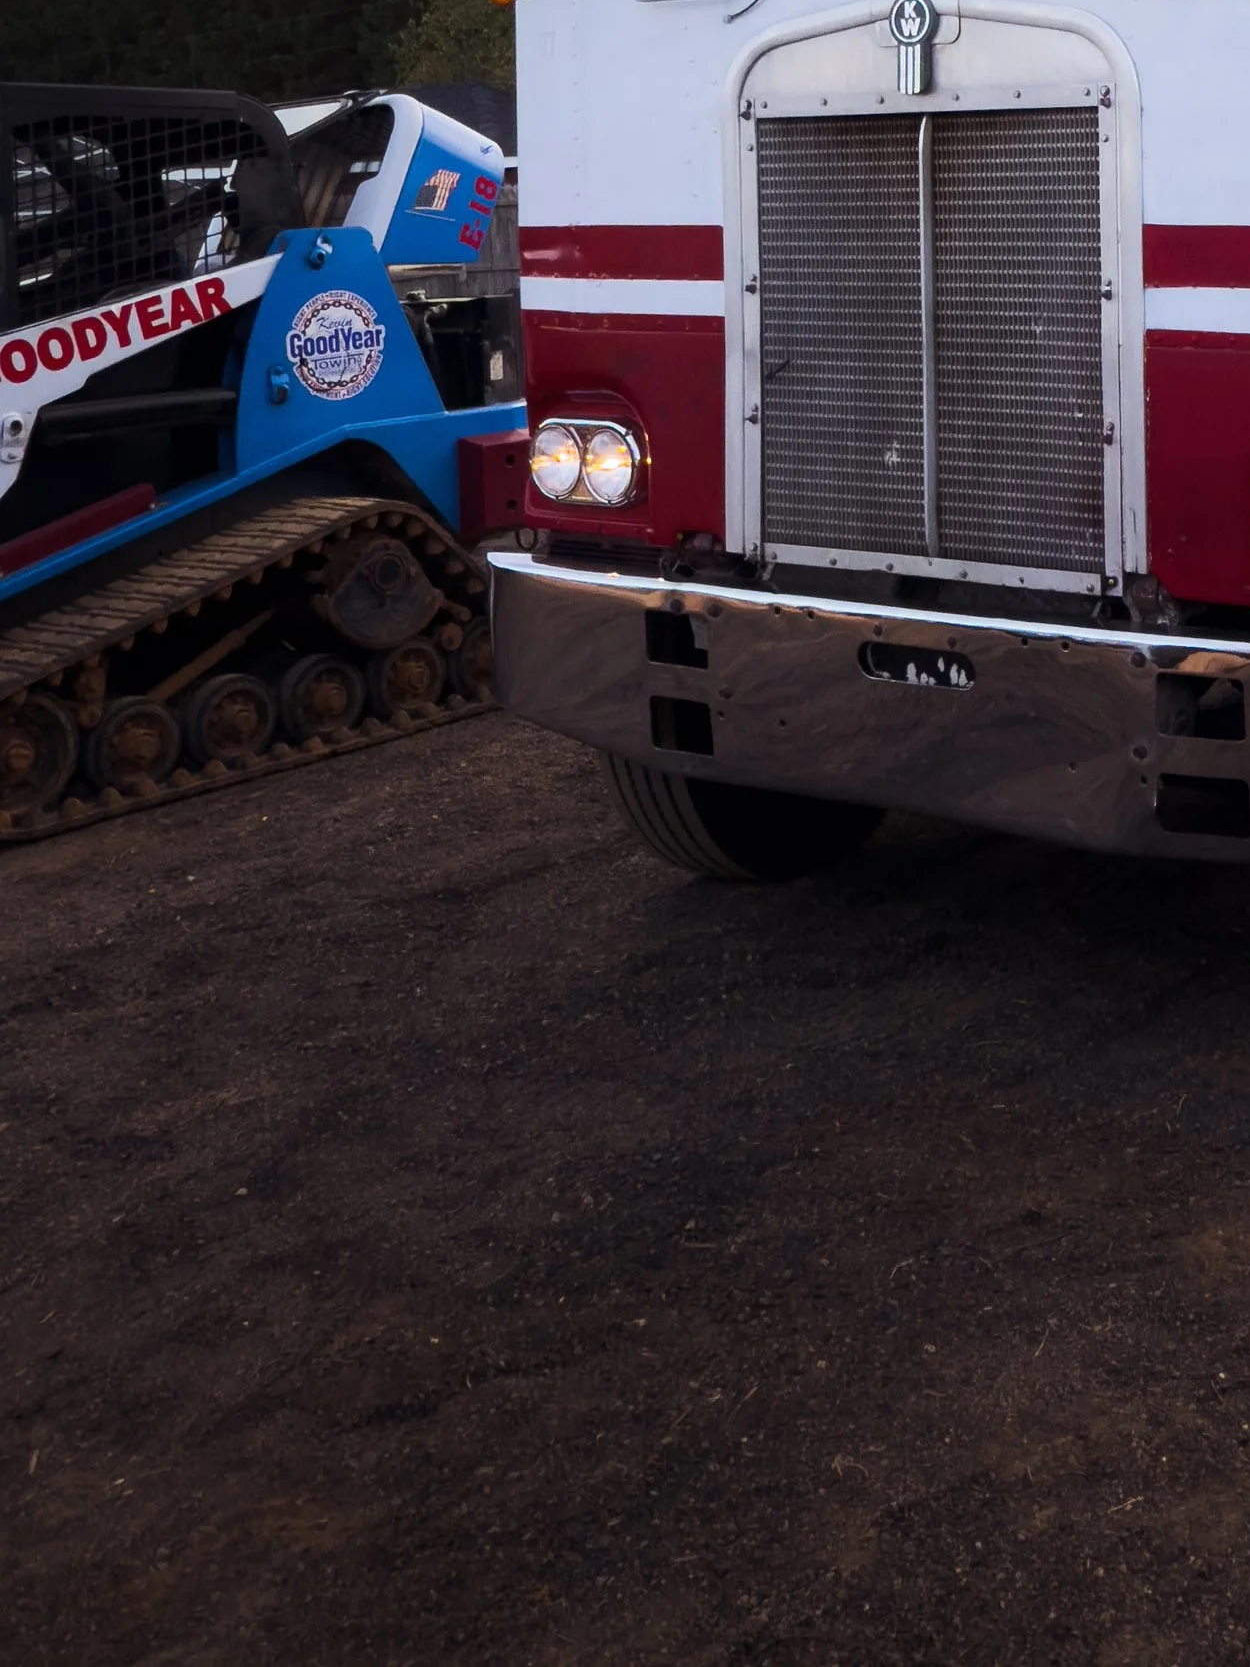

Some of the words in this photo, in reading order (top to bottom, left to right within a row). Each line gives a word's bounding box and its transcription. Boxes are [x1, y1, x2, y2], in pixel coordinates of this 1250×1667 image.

[458, 174, 498, 251] E-18
[0, 276, 234, 384] OODYEAR
[289, 326, 383, 359] GoodYear
[316, 316, 353, 330] Kevin
